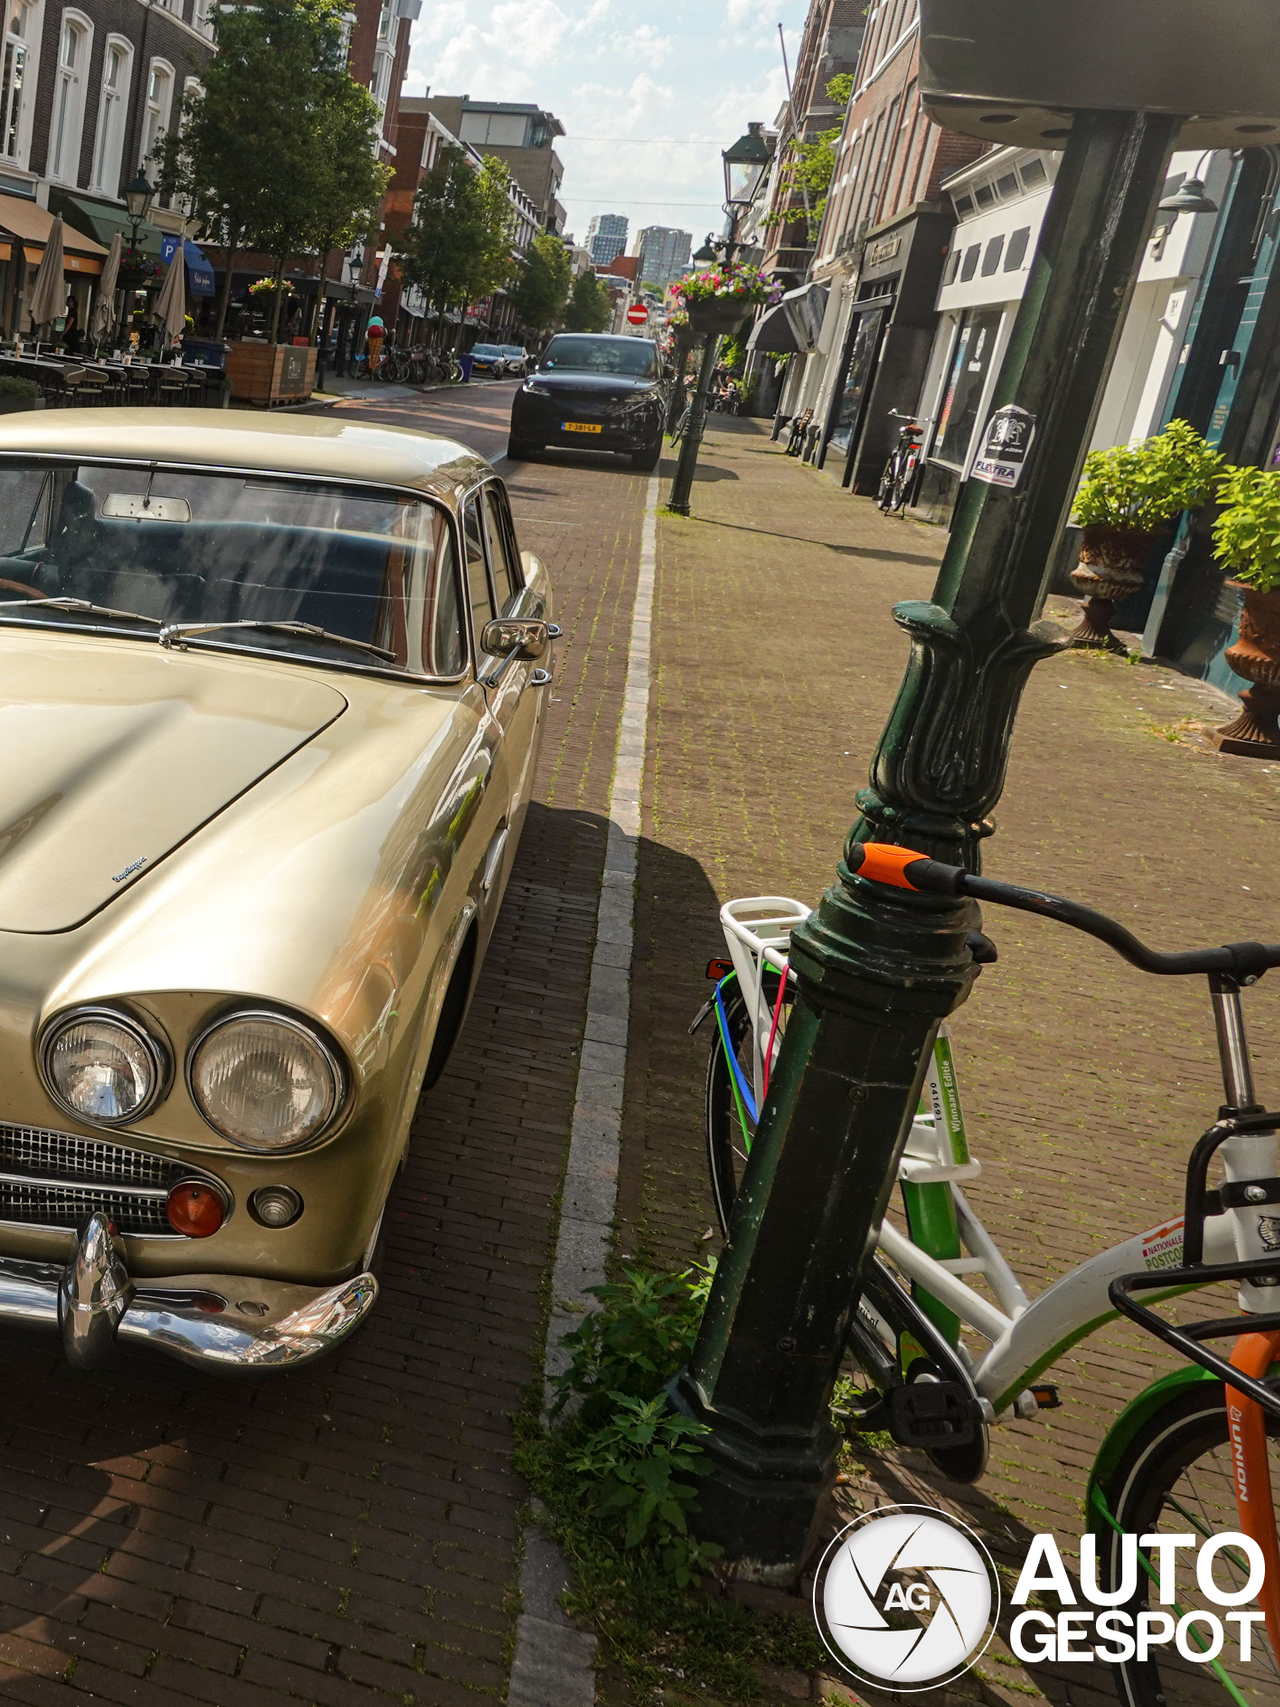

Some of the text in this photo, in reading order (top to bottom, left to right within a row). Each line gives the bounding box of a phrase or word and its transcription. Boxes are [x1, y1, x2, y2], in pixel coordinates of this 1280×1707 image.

[942, 1060, 954, 1088] Editie
[930, 1082, 942, 1121] 041691
[1148, 1235, 1183, 1256] NATIONALE
[1231, 1423, 1249, 1502] UNION
